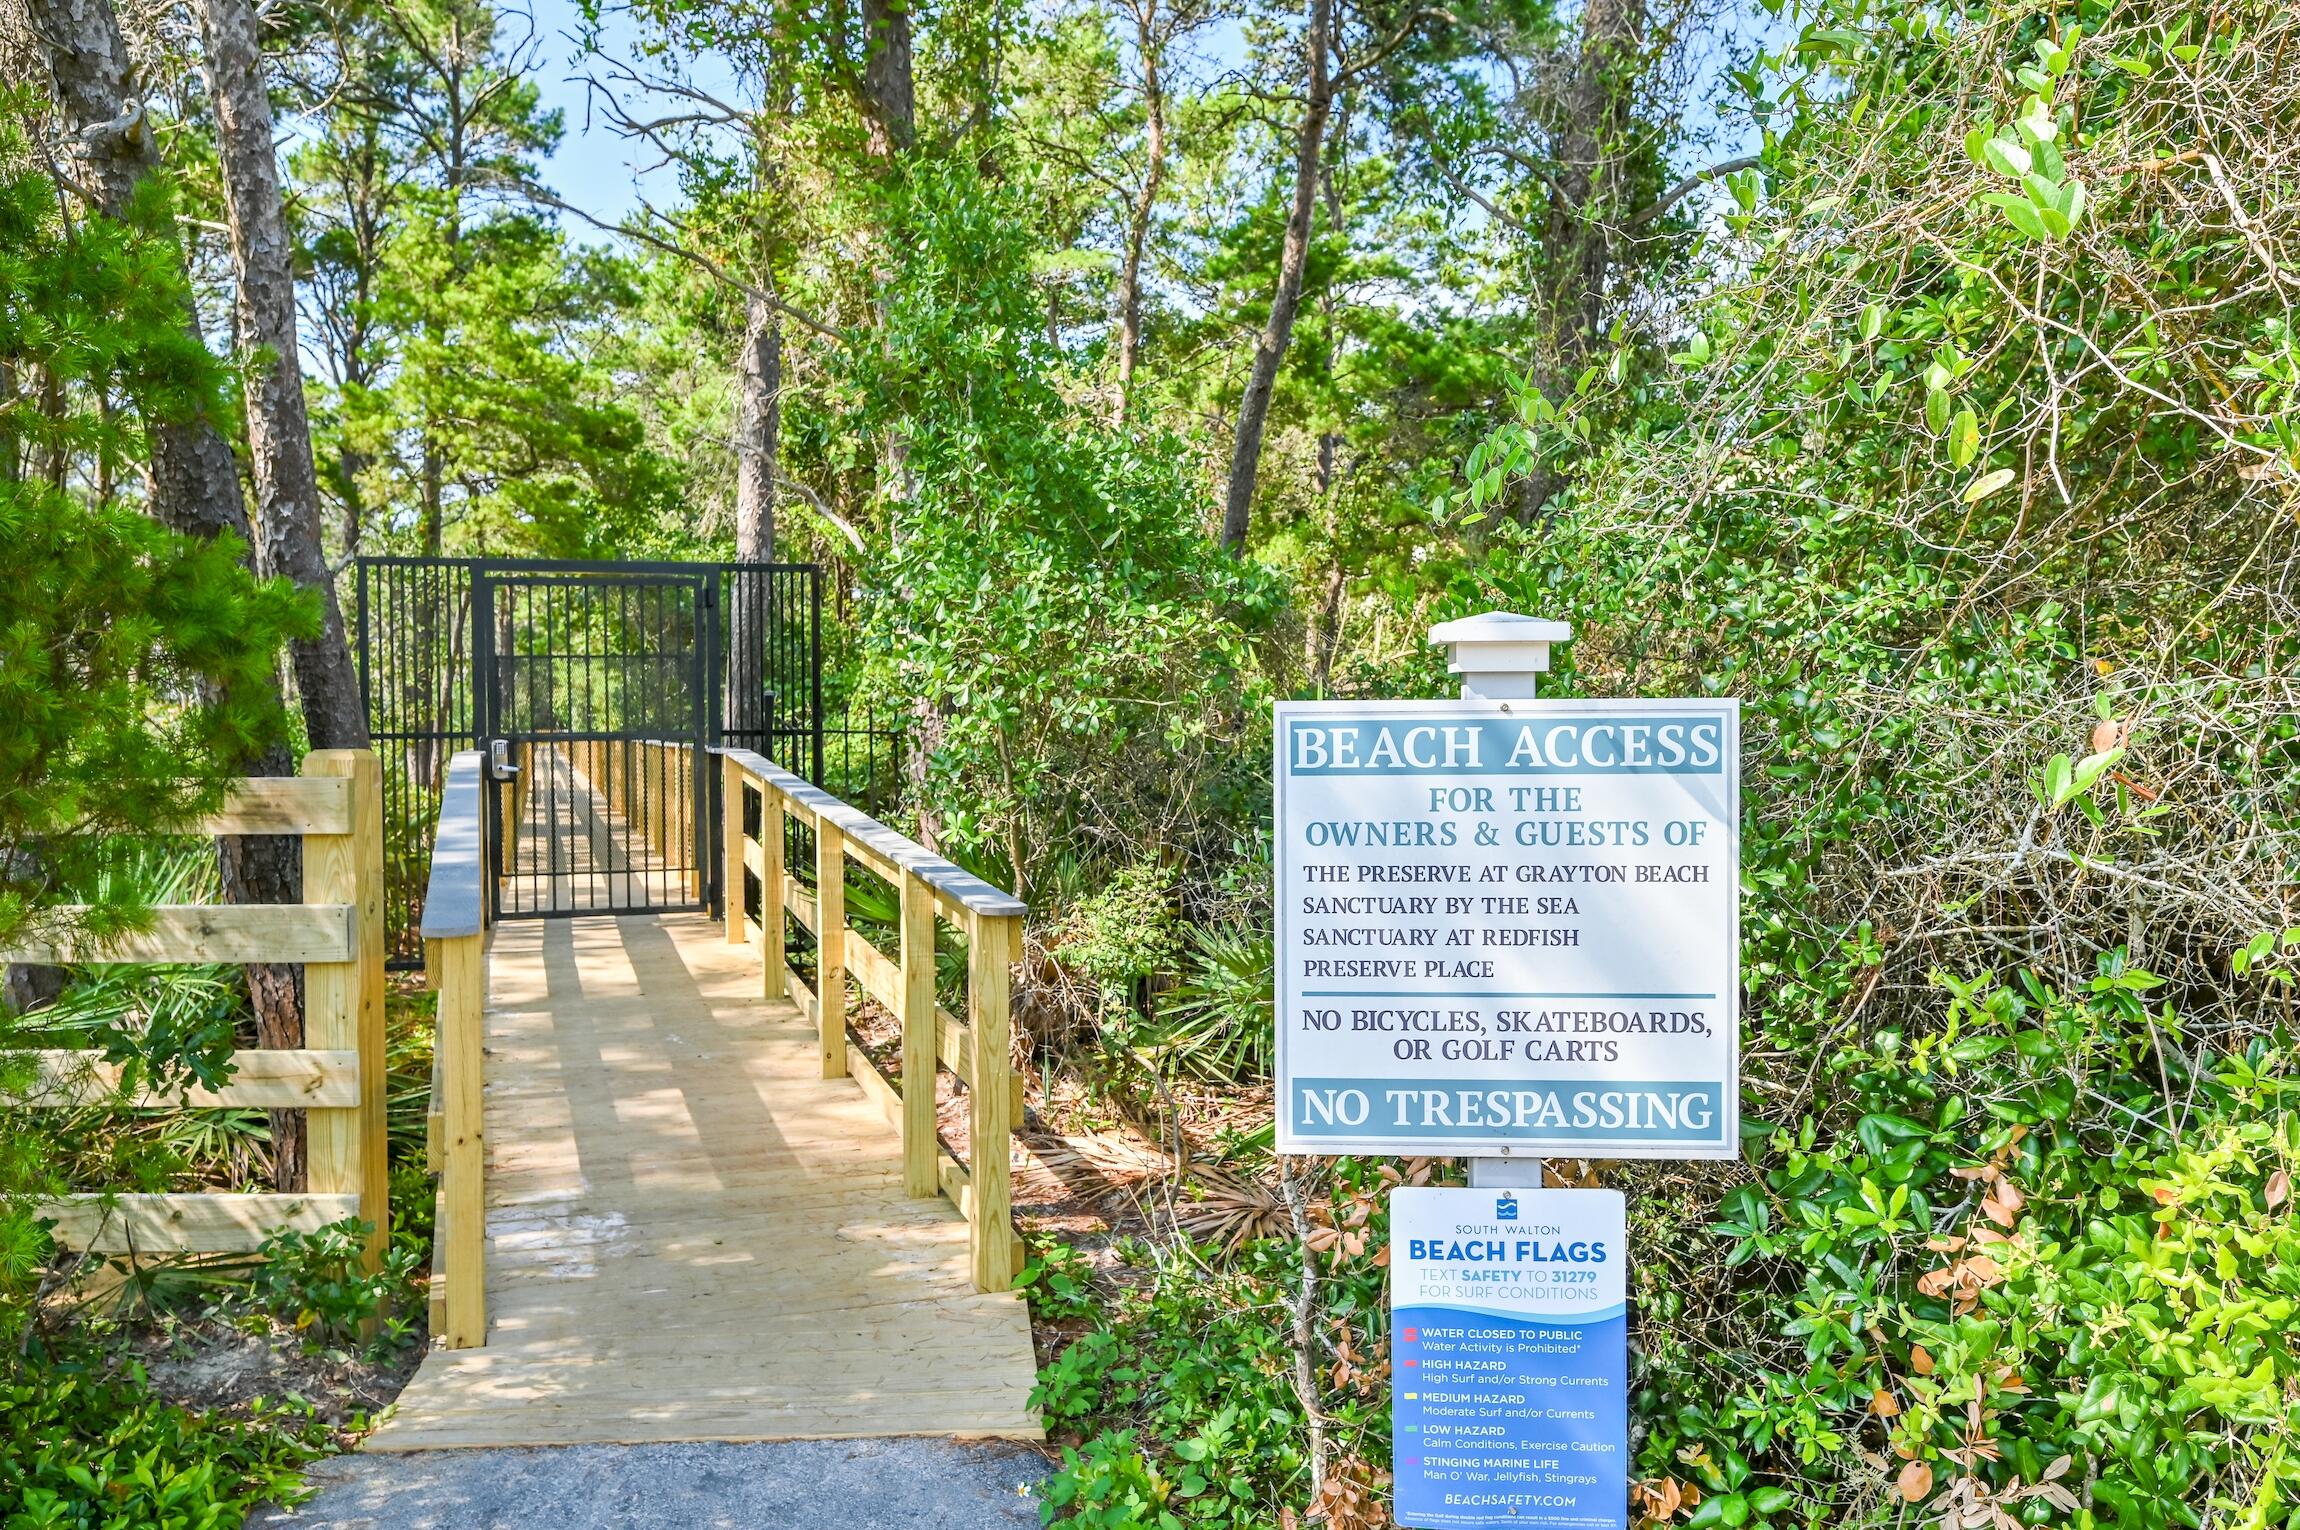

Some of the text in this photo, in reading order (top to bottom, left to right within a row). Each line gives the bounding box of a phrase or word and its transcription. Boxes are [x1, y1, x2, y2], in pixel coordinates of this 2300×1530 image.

[1294, 725, 1719, 769] BEACH ACCESS
[1429, 787, 1581, 812] FOR THE
[1306, 820, 1707, 846] OWNERS & GUESTS OF
[1303, 865, 1709, 883] THE PRESERVE AT GRAYTON BEACH
[1303, 896, 1579, 915] SANCTUARY BY THE SEA
[1303, 928, 1579, 947] SANCTUARY AT REDFISH
[1303, 960, 1494, 978] PRESERVE PLACE
[1302, 1009, 1712, 1038] NO BICYCLES, SKATEBOARDS,
[1393, 1038, 1618, 1061] OR GOLF CARTS
[1301, 1089, 1713, 1129] NO TRESPASSING
[1456, 1225, 1560, 1235] SOUTH WALTON
[1410, 1240, 1606, 1262] BEACH FLAGS
[1421, 1269, 1596, 1283] TEXT SAFETY TO 31279
[1420, 1285, 1598, 1300] FOR SURF CONDITIONS
[1422, 1328, 1582, 1340] WATER CLOSED TO PUBLIC
[1423, 1341, 1455, 1351] Water
[1460, 1341, 1501, 1354] Activity
[1506, 1343, 1514, 1352] is
[1423, 1360, 1506, 1371] HIGH HAZARD
[1423, 1373, 1609, 1387] High Surf and/or Strong Currents
[1423, 1393, 1525, 1404] MEDIUM HAZARD
[1423, 1406, 1595, 1419] Moderate Surf and/or Currents
[1424, 1425, 1505, 1436] LOW HAZARD
[1424, 1438, 1615, 1452] Calm Conditions, Exercise Caution
[1424, 1457, 1559, 1469] STINGING MARINE LIFE
[1424, 1471, 1446, 1480] Man
[1466, 1472, 1490, 1482] War,
[1494, 1472, 1541, 1484] Jellyfish,
[1545, 1474, 1597, 1485] Stingrays
[1445, 1494, 1576, 1507] BEACHSAFETY.COM
